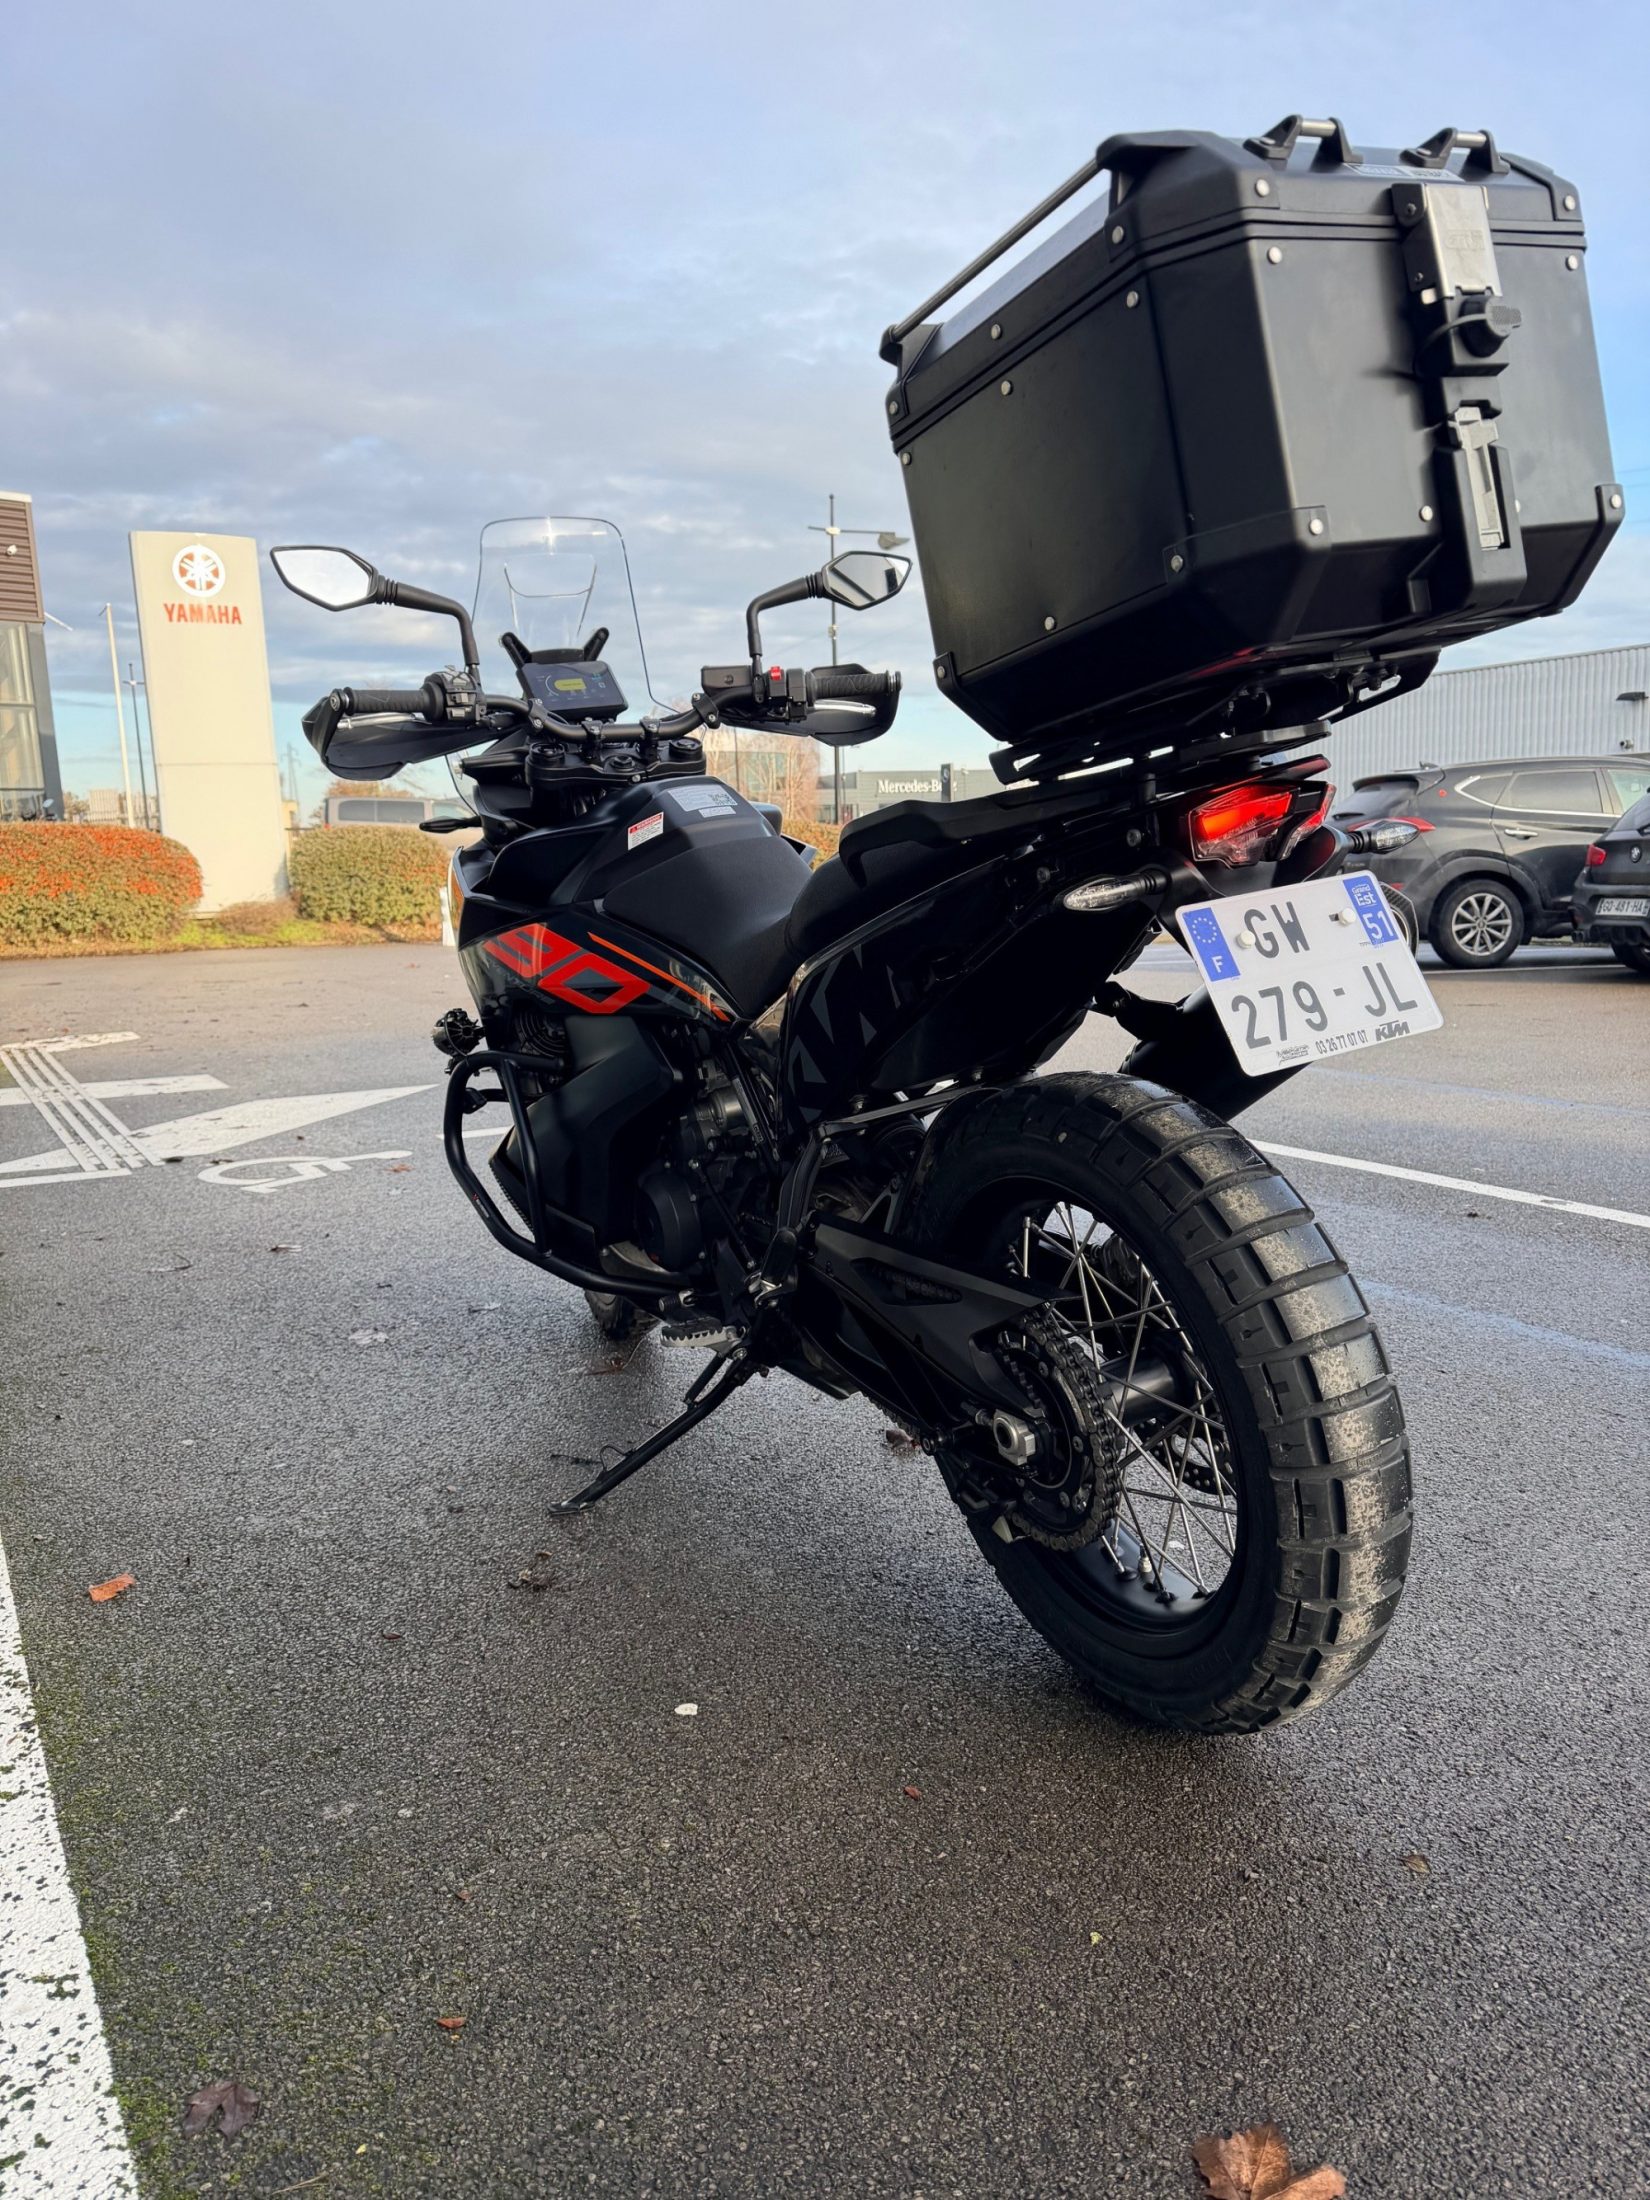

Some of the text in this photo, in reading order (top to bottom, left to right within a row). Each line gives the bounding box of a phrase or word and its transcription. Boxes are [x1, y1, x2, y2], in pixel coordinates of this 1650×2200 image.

[163, 603, 242, 625] YAMAHA
[878, 779, 958, 794] Mercedes-Bez
[1355, 892, 1377, 907] Est
[1244, 901, 1311, 959] GW
[1362, 910, 1394, 939] 51
[1211, 955, 1223, 973] F
[1375, 1020, 1410, 1041] KTM
[1315, 1041, 1326, 1055] 03
[1326, 1038, 1338, 1052] 26
[1336, 1035, 1348, 1050] 77
[1347, 1032, 1358, 1046] 07
[1358, 1029, 1369, 1043] 07
